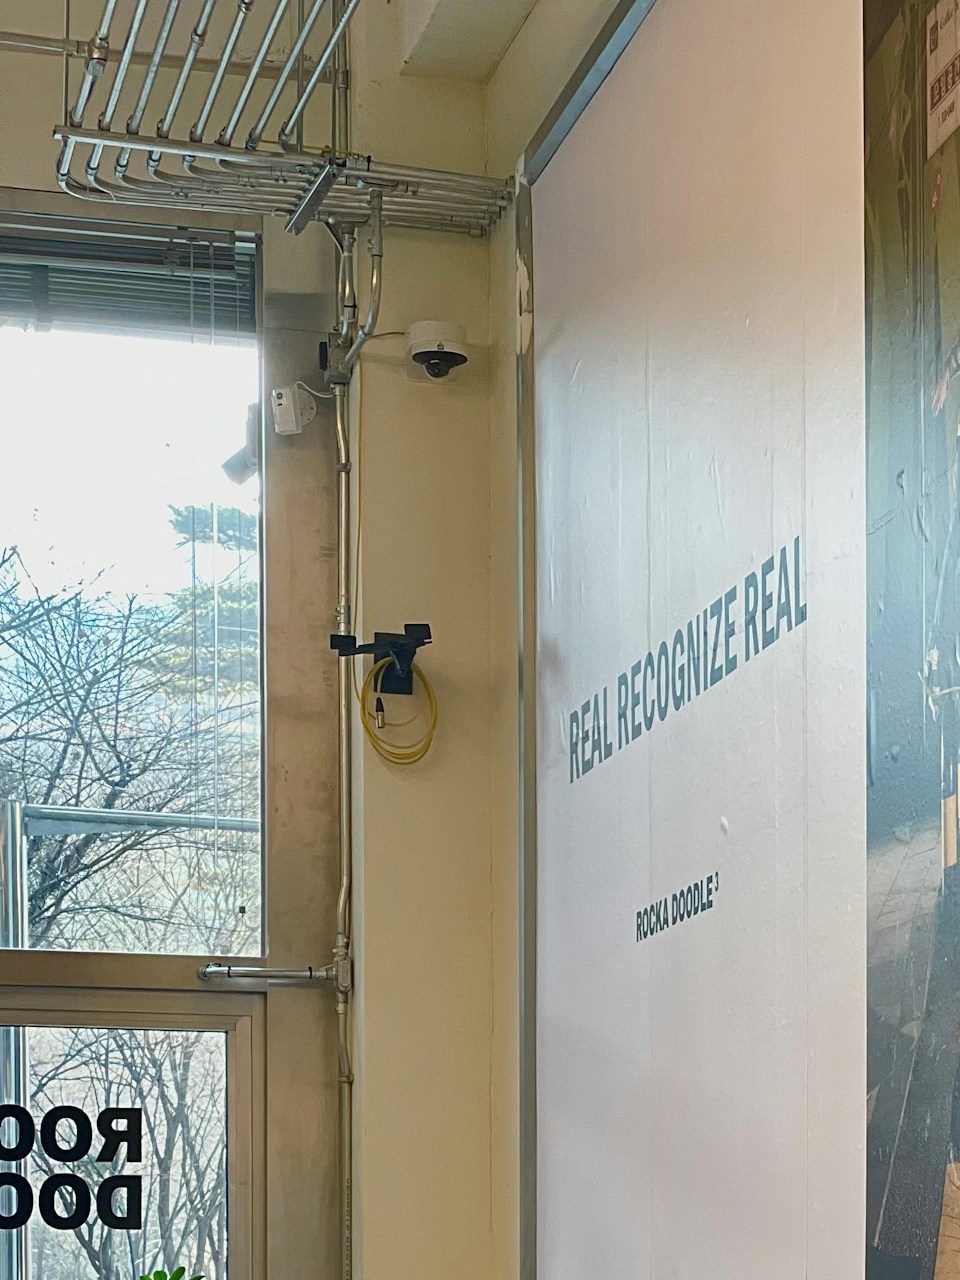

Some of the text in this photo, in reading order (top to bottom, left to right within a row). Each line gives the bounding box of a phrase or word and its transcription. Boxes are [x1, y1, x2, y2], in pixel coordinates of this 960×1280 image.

[570, 536, 807, 784] REAL RECOGNIZE REAL
[636, 897, 669, 942] ROCKA
